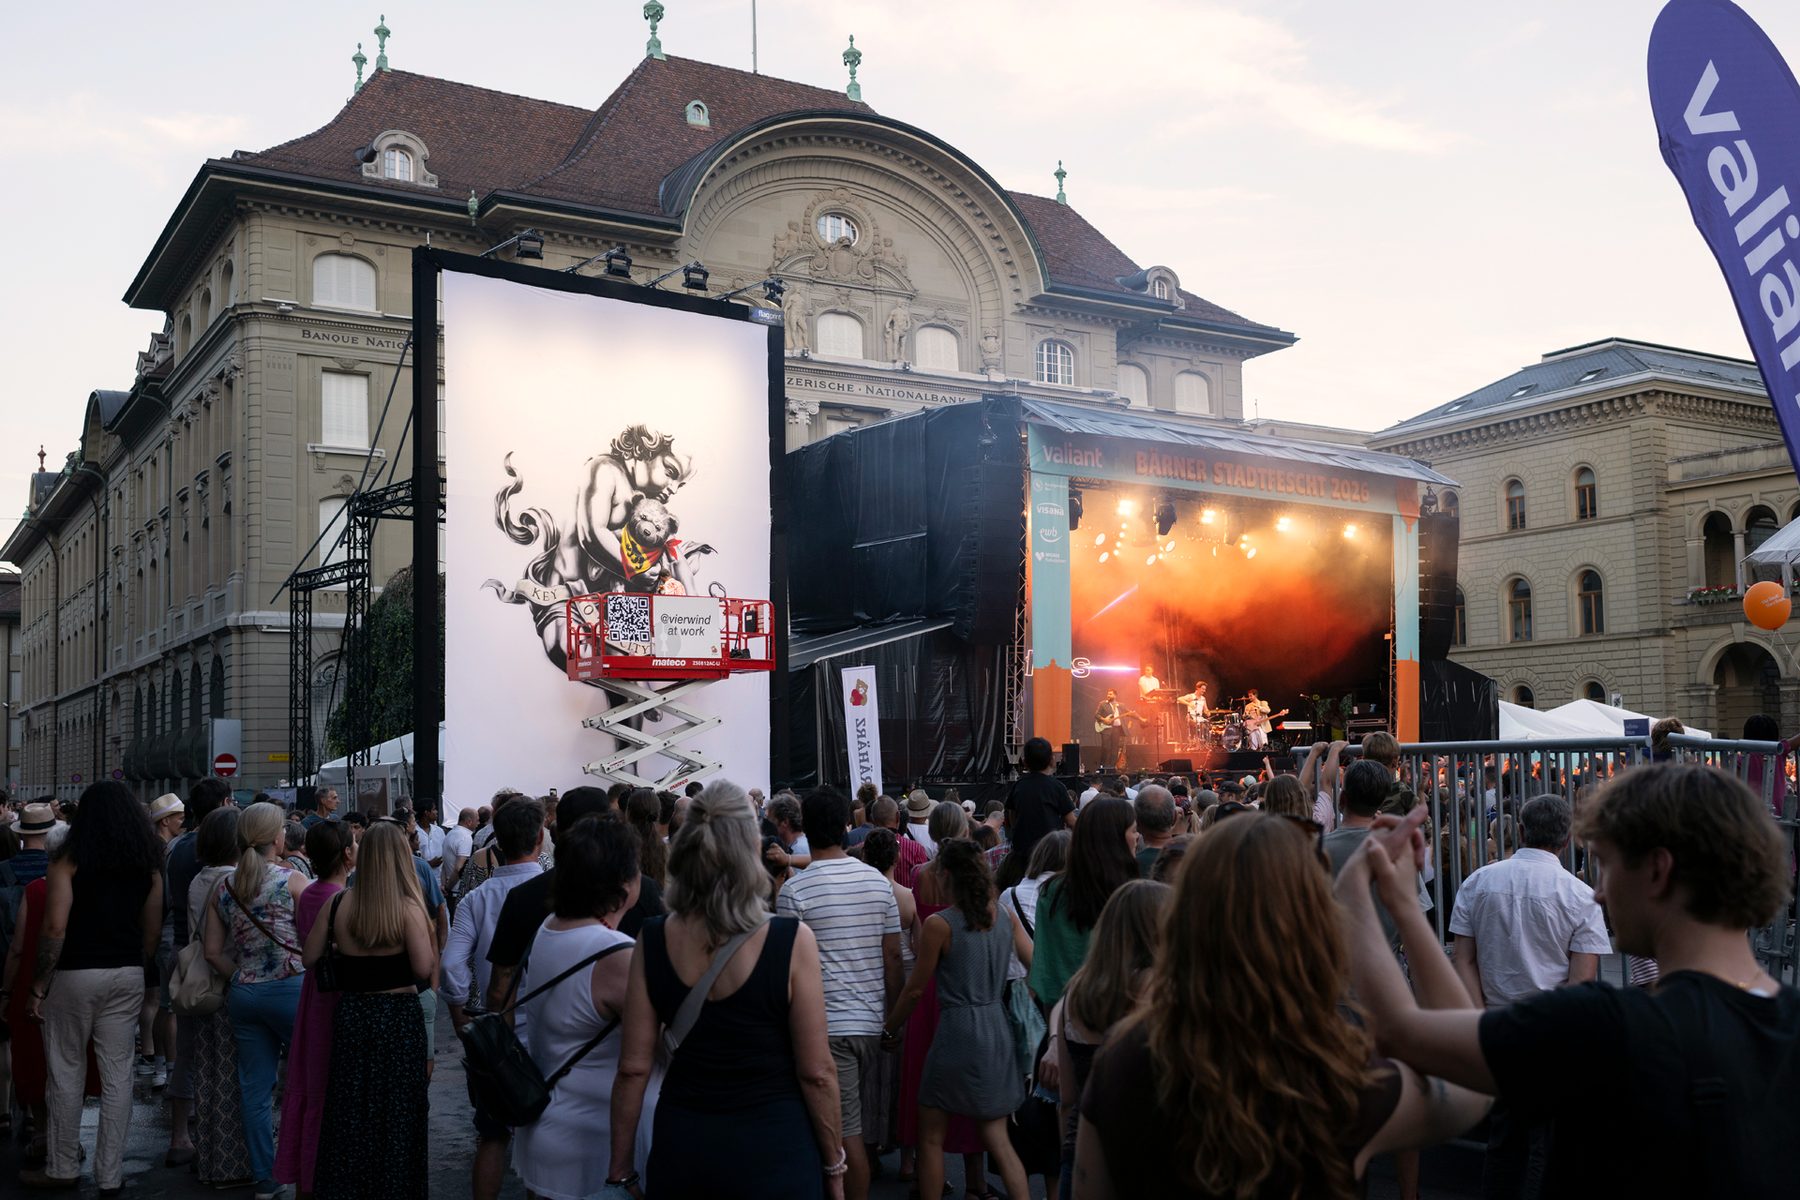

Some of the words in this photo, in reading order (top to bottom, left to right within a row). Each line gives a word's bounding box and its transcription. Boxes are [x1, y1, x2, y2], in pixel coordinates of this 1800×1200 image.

[302, 329, 359, 344] BANQUE
[366, 336, 413, 350] NATIO
[865, 384, 966, 403] NATIONALBANK
[1042, 442, 1104, 468] valiant
[1135, 450, 1207, 482] BÄRNER
[1213, 462, 1327, 497] STADTFESCHT
[1331, 477, 1370, 503] 2026
[532, 587, 558, 601] KEY
[660, 613, 711, 625] @vierwind
[667, 627, 677, 636] at
[680, 627, 705, 636] work
[652, 658, 686, 666] mateco
